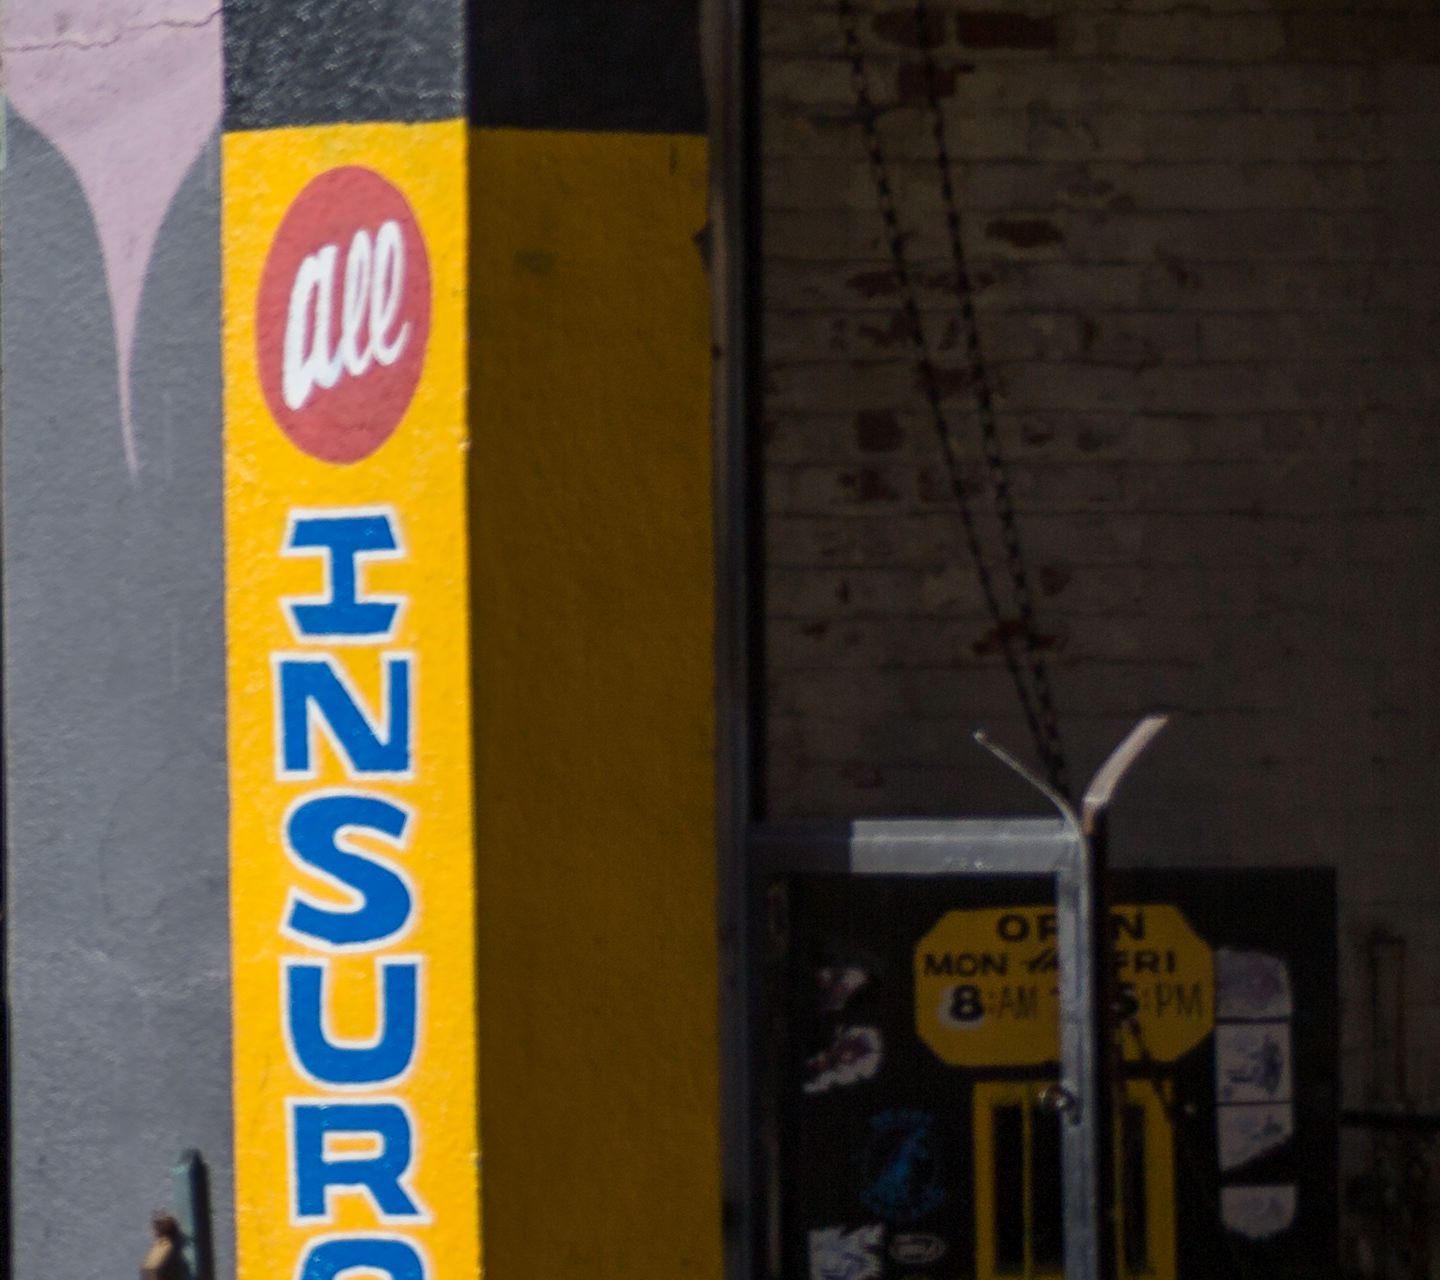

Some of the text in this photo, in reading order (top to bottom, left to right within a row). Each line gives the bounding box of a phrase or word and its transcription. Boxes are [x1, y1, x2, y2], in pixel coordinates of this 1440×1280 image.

[996, 912, 1146, 942] OPN
[923, 951, 1009, 977] MON
[1110, 950, 1177, 975] FRI
